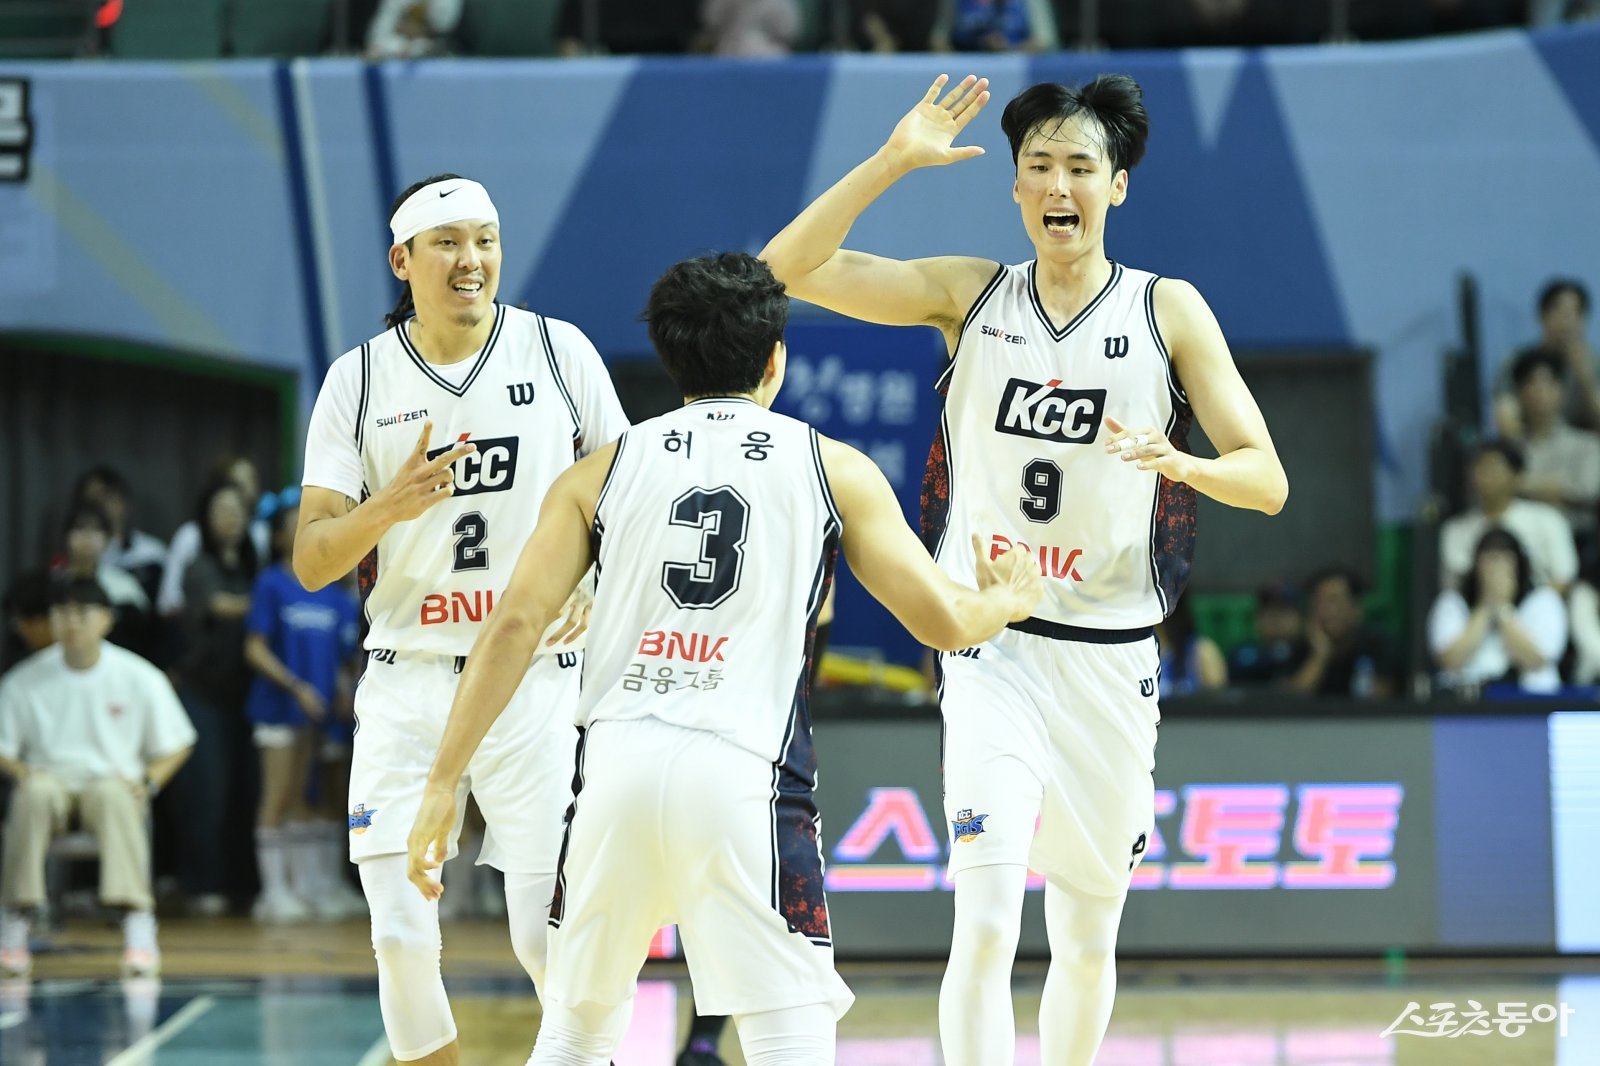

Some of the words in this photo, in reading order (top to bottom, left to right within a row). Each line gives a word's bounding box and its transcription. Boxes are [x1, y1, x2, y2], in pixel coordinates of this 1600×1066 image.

[1004, 379, 1095, 439] KCC
[452, 432, 510, 490] CC
[662, 429, 693, 460] 허
[740, 431, 774, 461] 웅
[1020, 457, 1063, 524] 9
[451, 511, 489, 573] 2
[661, 485, 750, 610] 3
[638, 631, 729, 663] BNK
[824, 782, 1404, 890] 스토토
